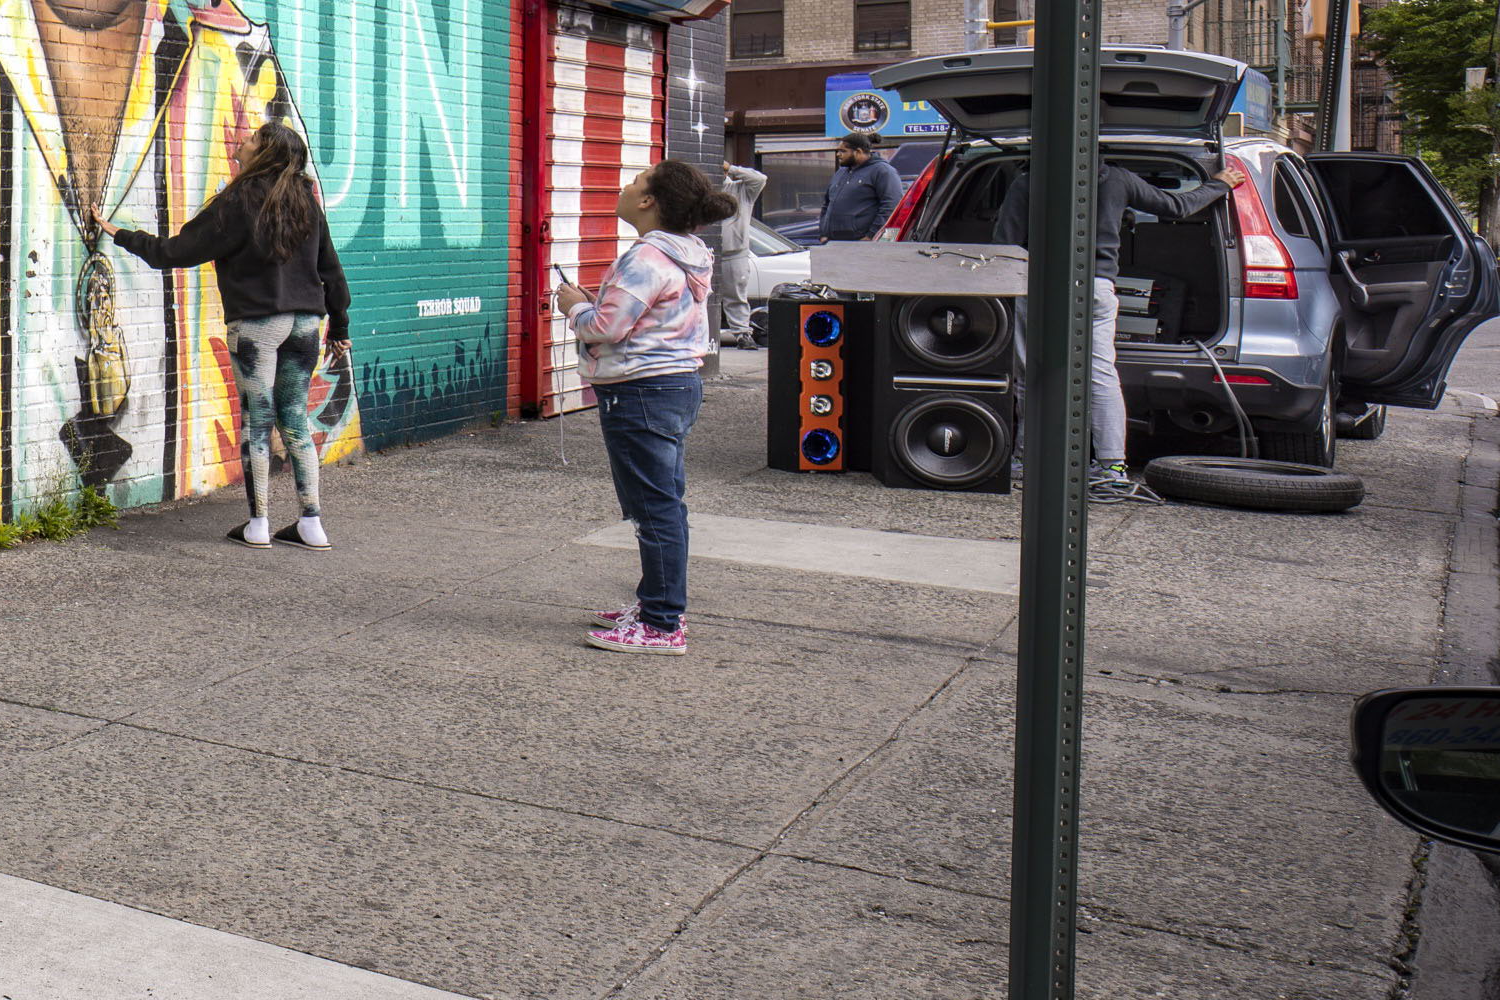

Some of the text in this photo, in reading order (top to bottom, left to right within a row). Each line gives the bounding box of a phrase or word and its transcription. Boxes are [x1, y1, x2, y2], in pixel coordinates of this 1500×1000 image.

[852, 125, 877, 134] SENATE
[907, 125, 928, 133] TEL:
[453, 296, 482, 316] SQUAD
